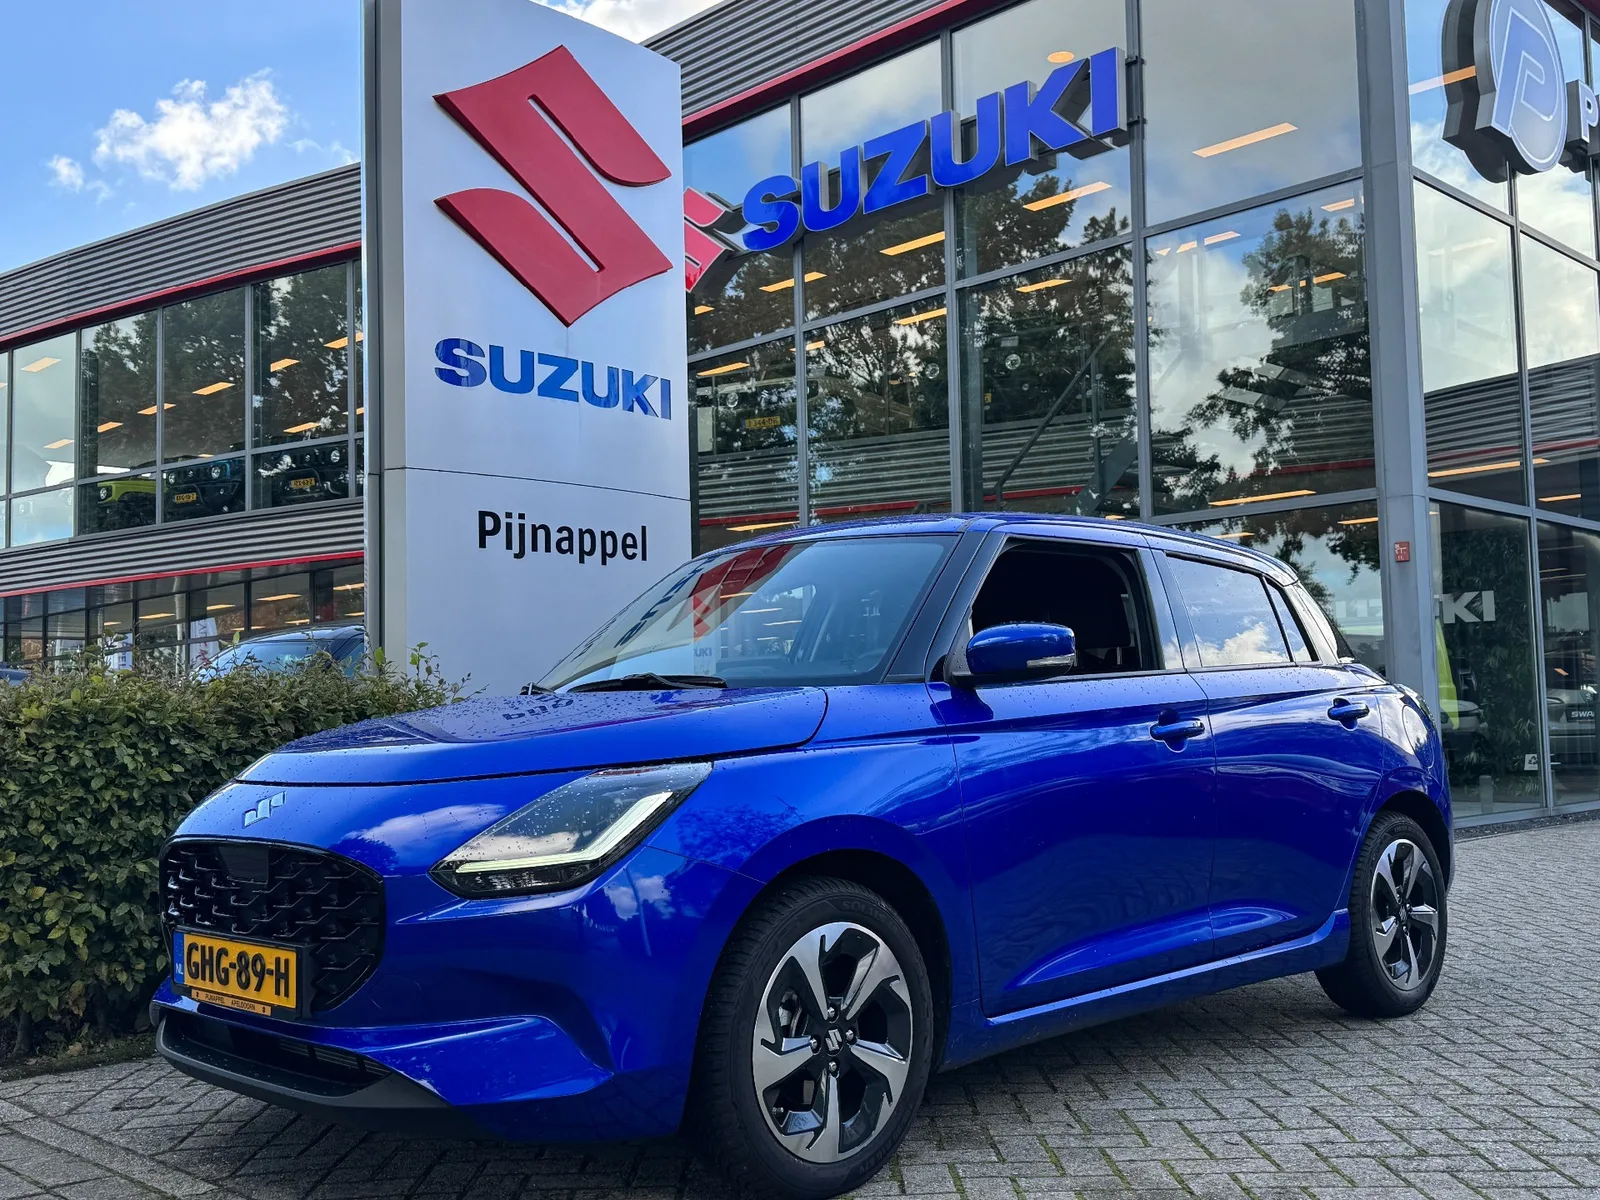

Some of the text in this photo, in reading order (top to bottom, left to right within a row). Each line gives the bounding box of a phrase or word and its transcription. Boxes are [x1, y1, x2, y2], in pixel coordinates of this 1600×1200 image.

[742, 46, 1125, 252] SUZUKI
[434, 337, 671, 421] SUZUKI
[477, 510, 648, 566] Pijnappel
[1442, 590, 1496, 624] KI
[175, 941, 290, 998] NL GHG-89-H
